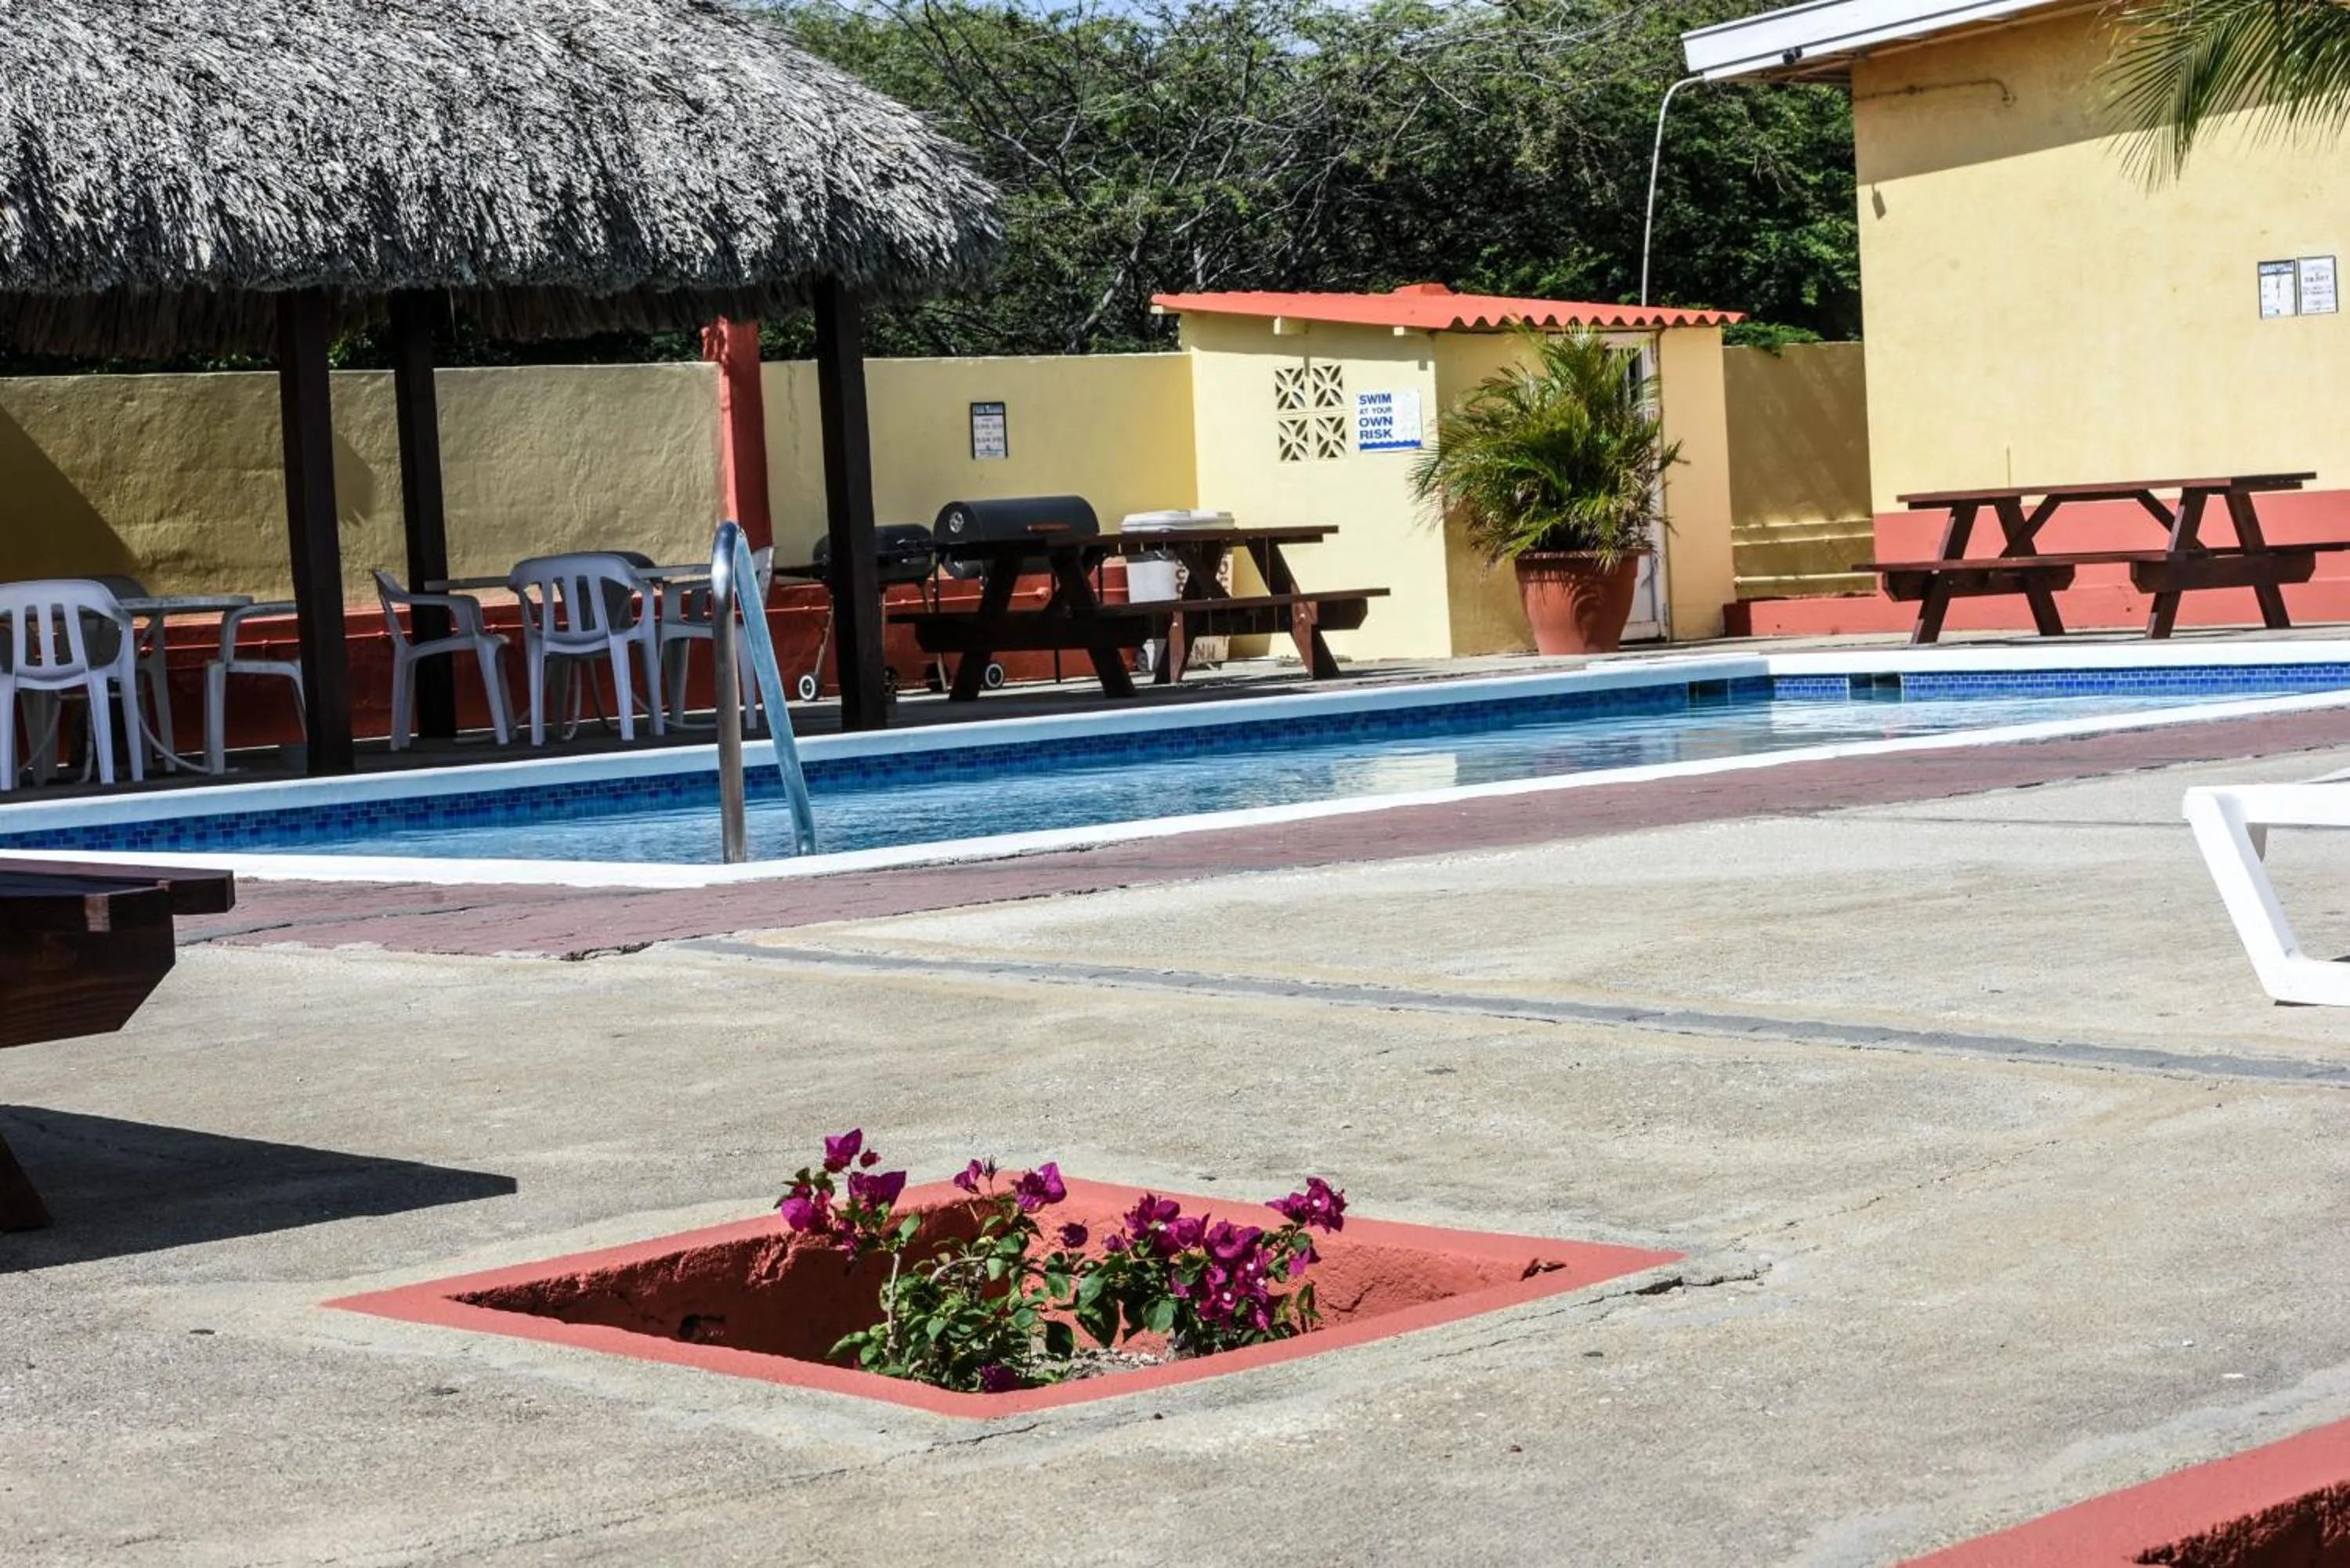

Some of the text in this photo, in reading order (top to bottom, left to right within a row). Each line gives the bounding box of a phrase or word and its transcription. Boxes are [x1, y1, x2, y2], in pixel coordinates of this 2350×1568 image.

[1359, 392, 1392, 405] SWIM
[1358, 416, 1393, 428] OWN
[1359, 428, 1393, 439] RISK
